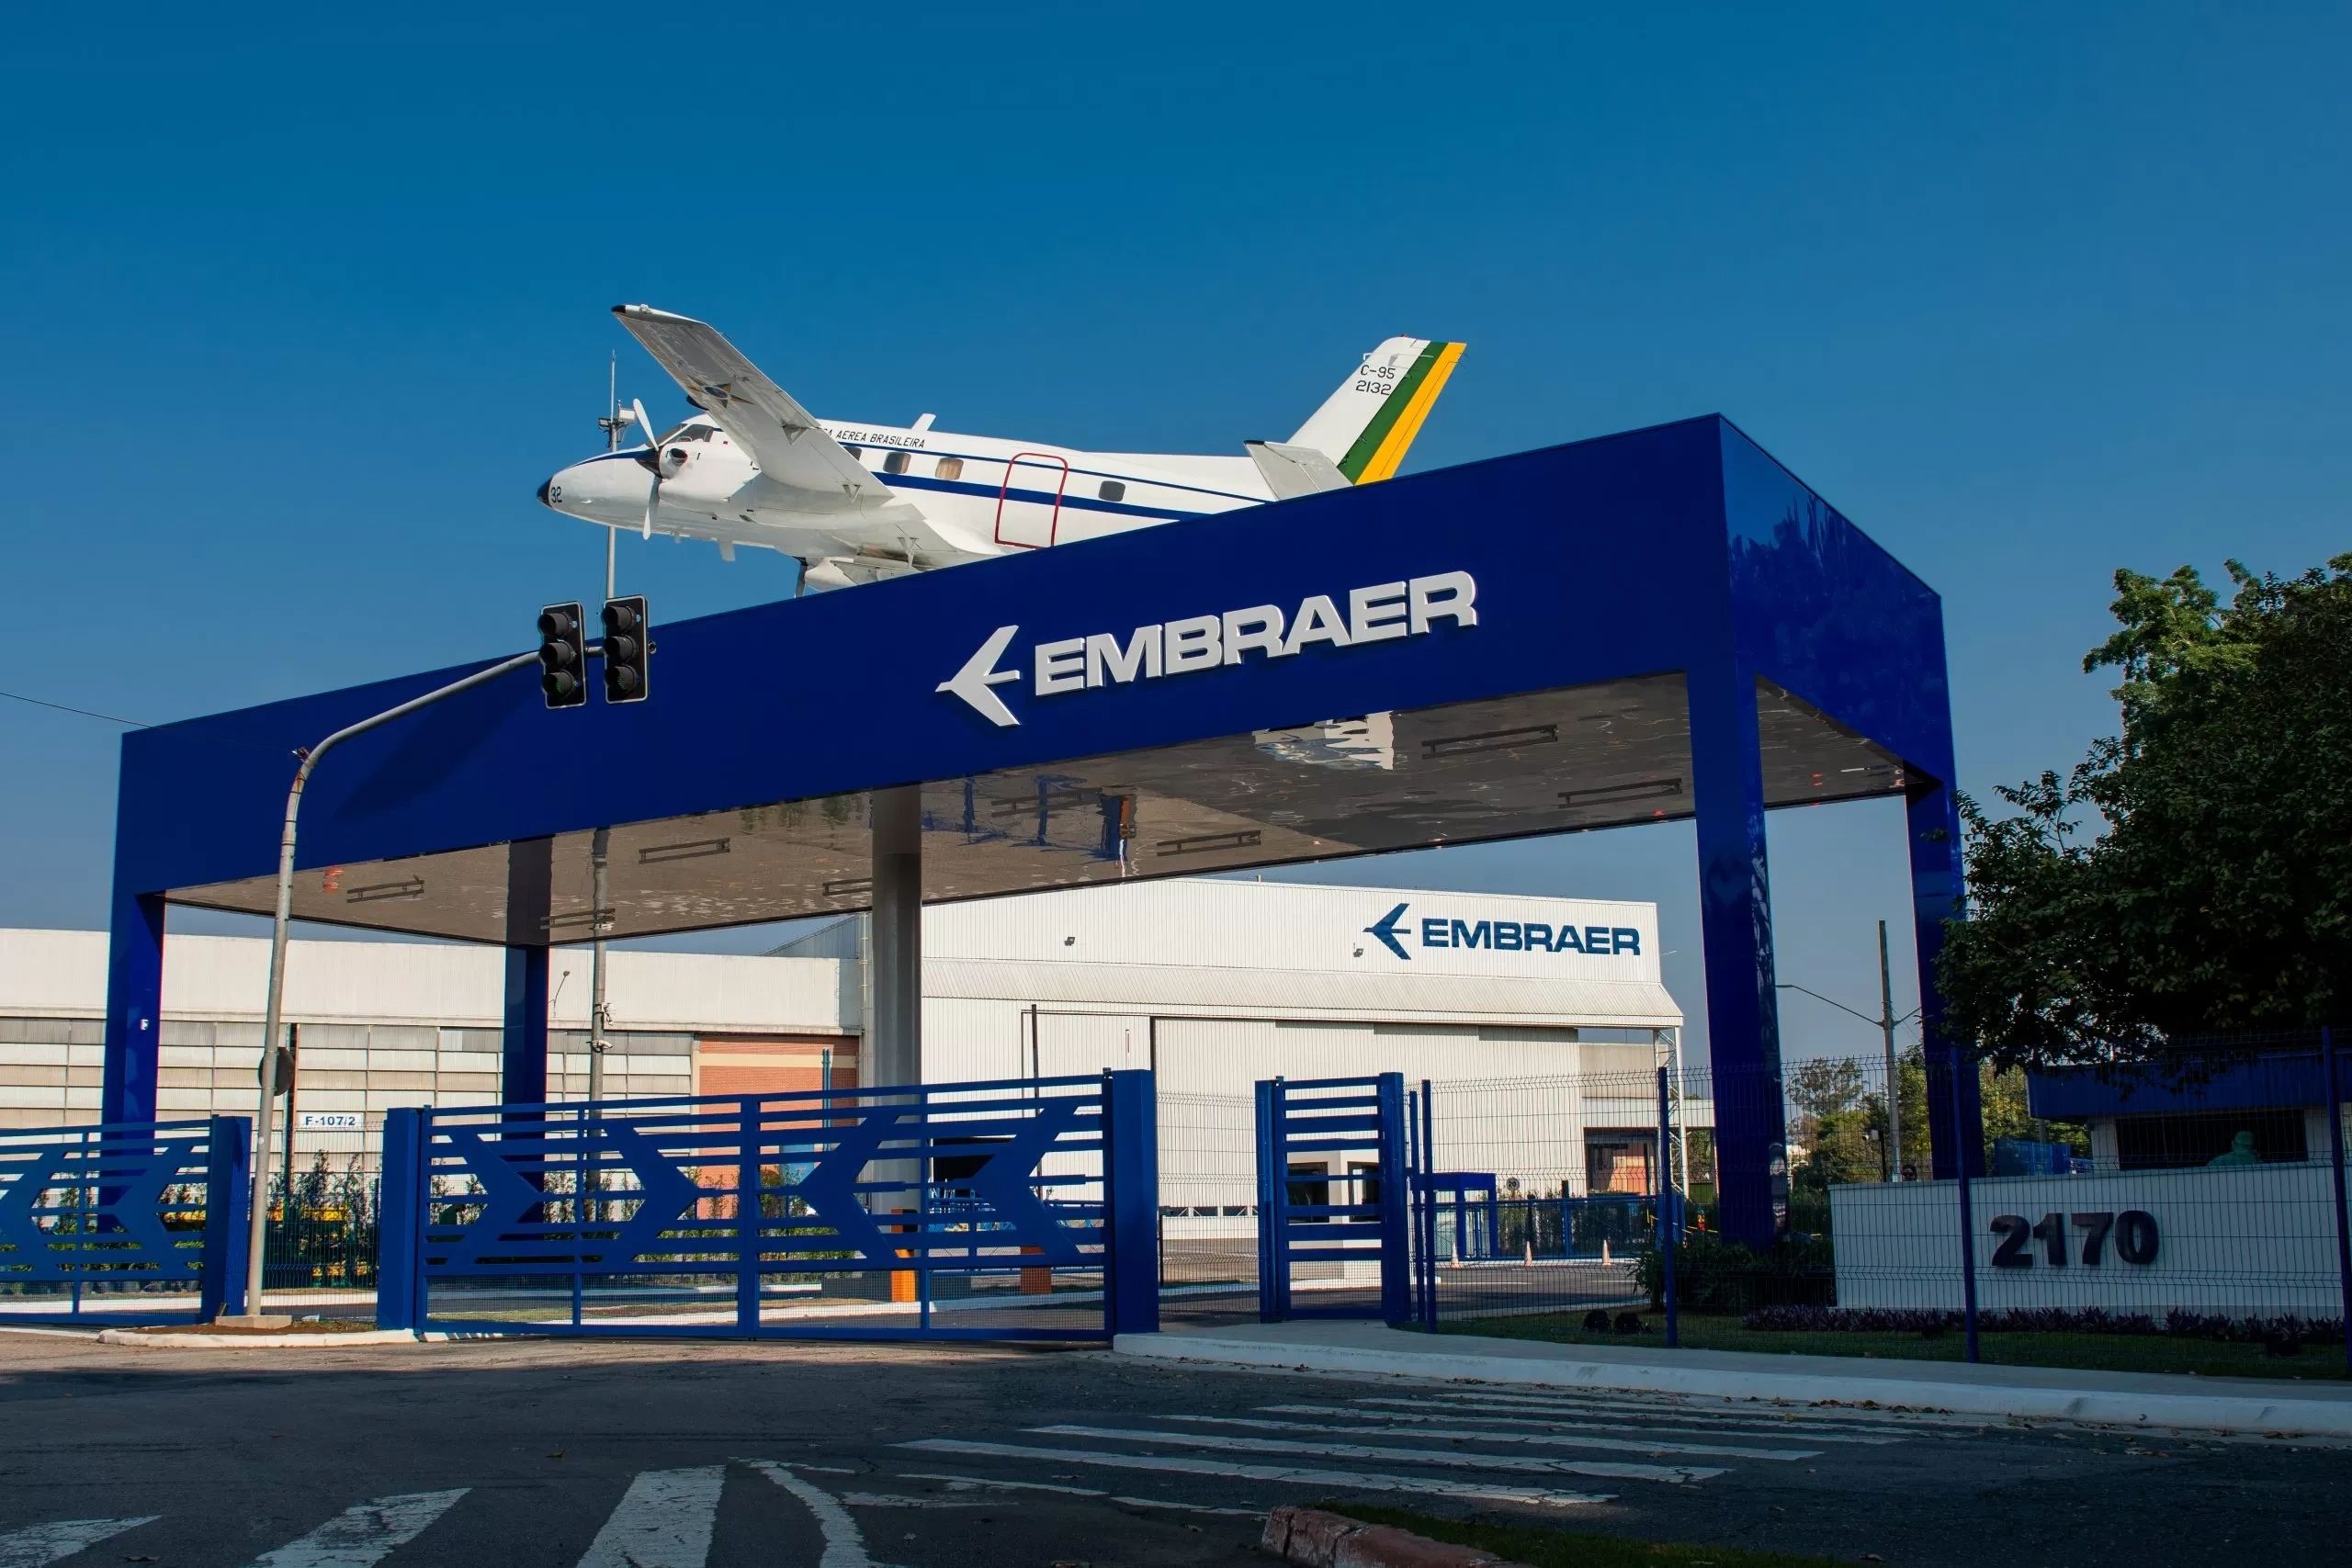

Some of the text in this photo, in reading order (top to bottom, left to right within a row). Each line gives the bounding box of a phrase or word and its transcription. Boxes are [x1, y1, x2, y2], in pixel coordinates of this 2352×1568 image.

[1360, 364, 1396, 379] C-95
[1355, 379, 1392, 396] 2132
[835, 430, 866, 442] AEREA
[869, 433, 925, 449] BRASILEIRA
[550, 485, 563, 503] 32
[1035, 570, 1478, 696] EMBRAER
[1421, 918, 1641, 956] EMBRAER
[305, 1115, 356, 1126] F-107/2
[1989, 1209, 2160, 1267] 2170
